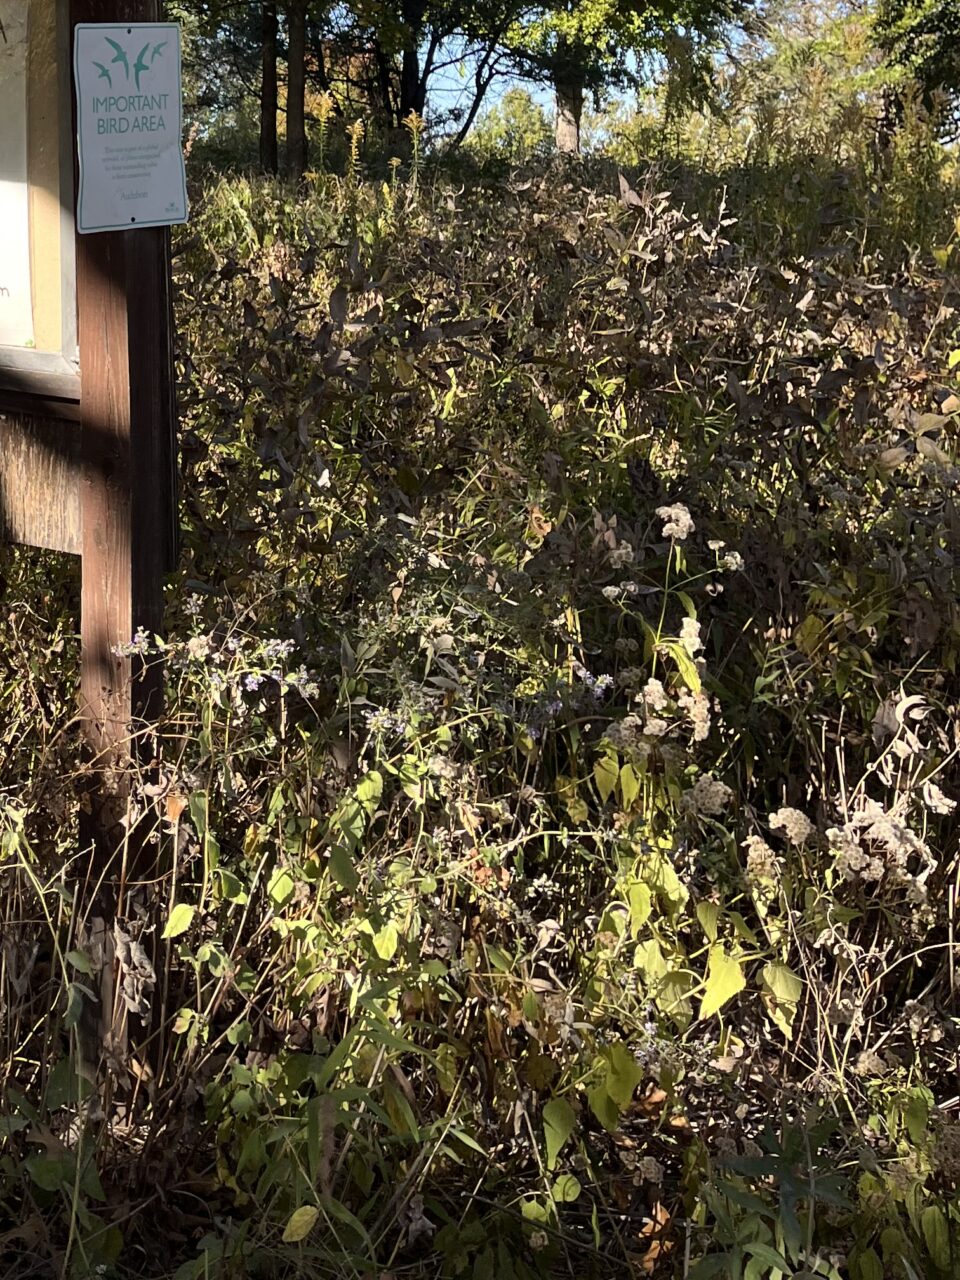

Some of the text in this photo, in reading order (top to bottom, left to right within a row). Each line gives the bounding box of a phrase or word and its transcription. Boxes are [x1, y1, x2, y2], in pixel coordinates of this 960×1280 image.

[92, 94, 169, 113] IMPORTANT
[97, 116, 166, 135] BIRD AREA
